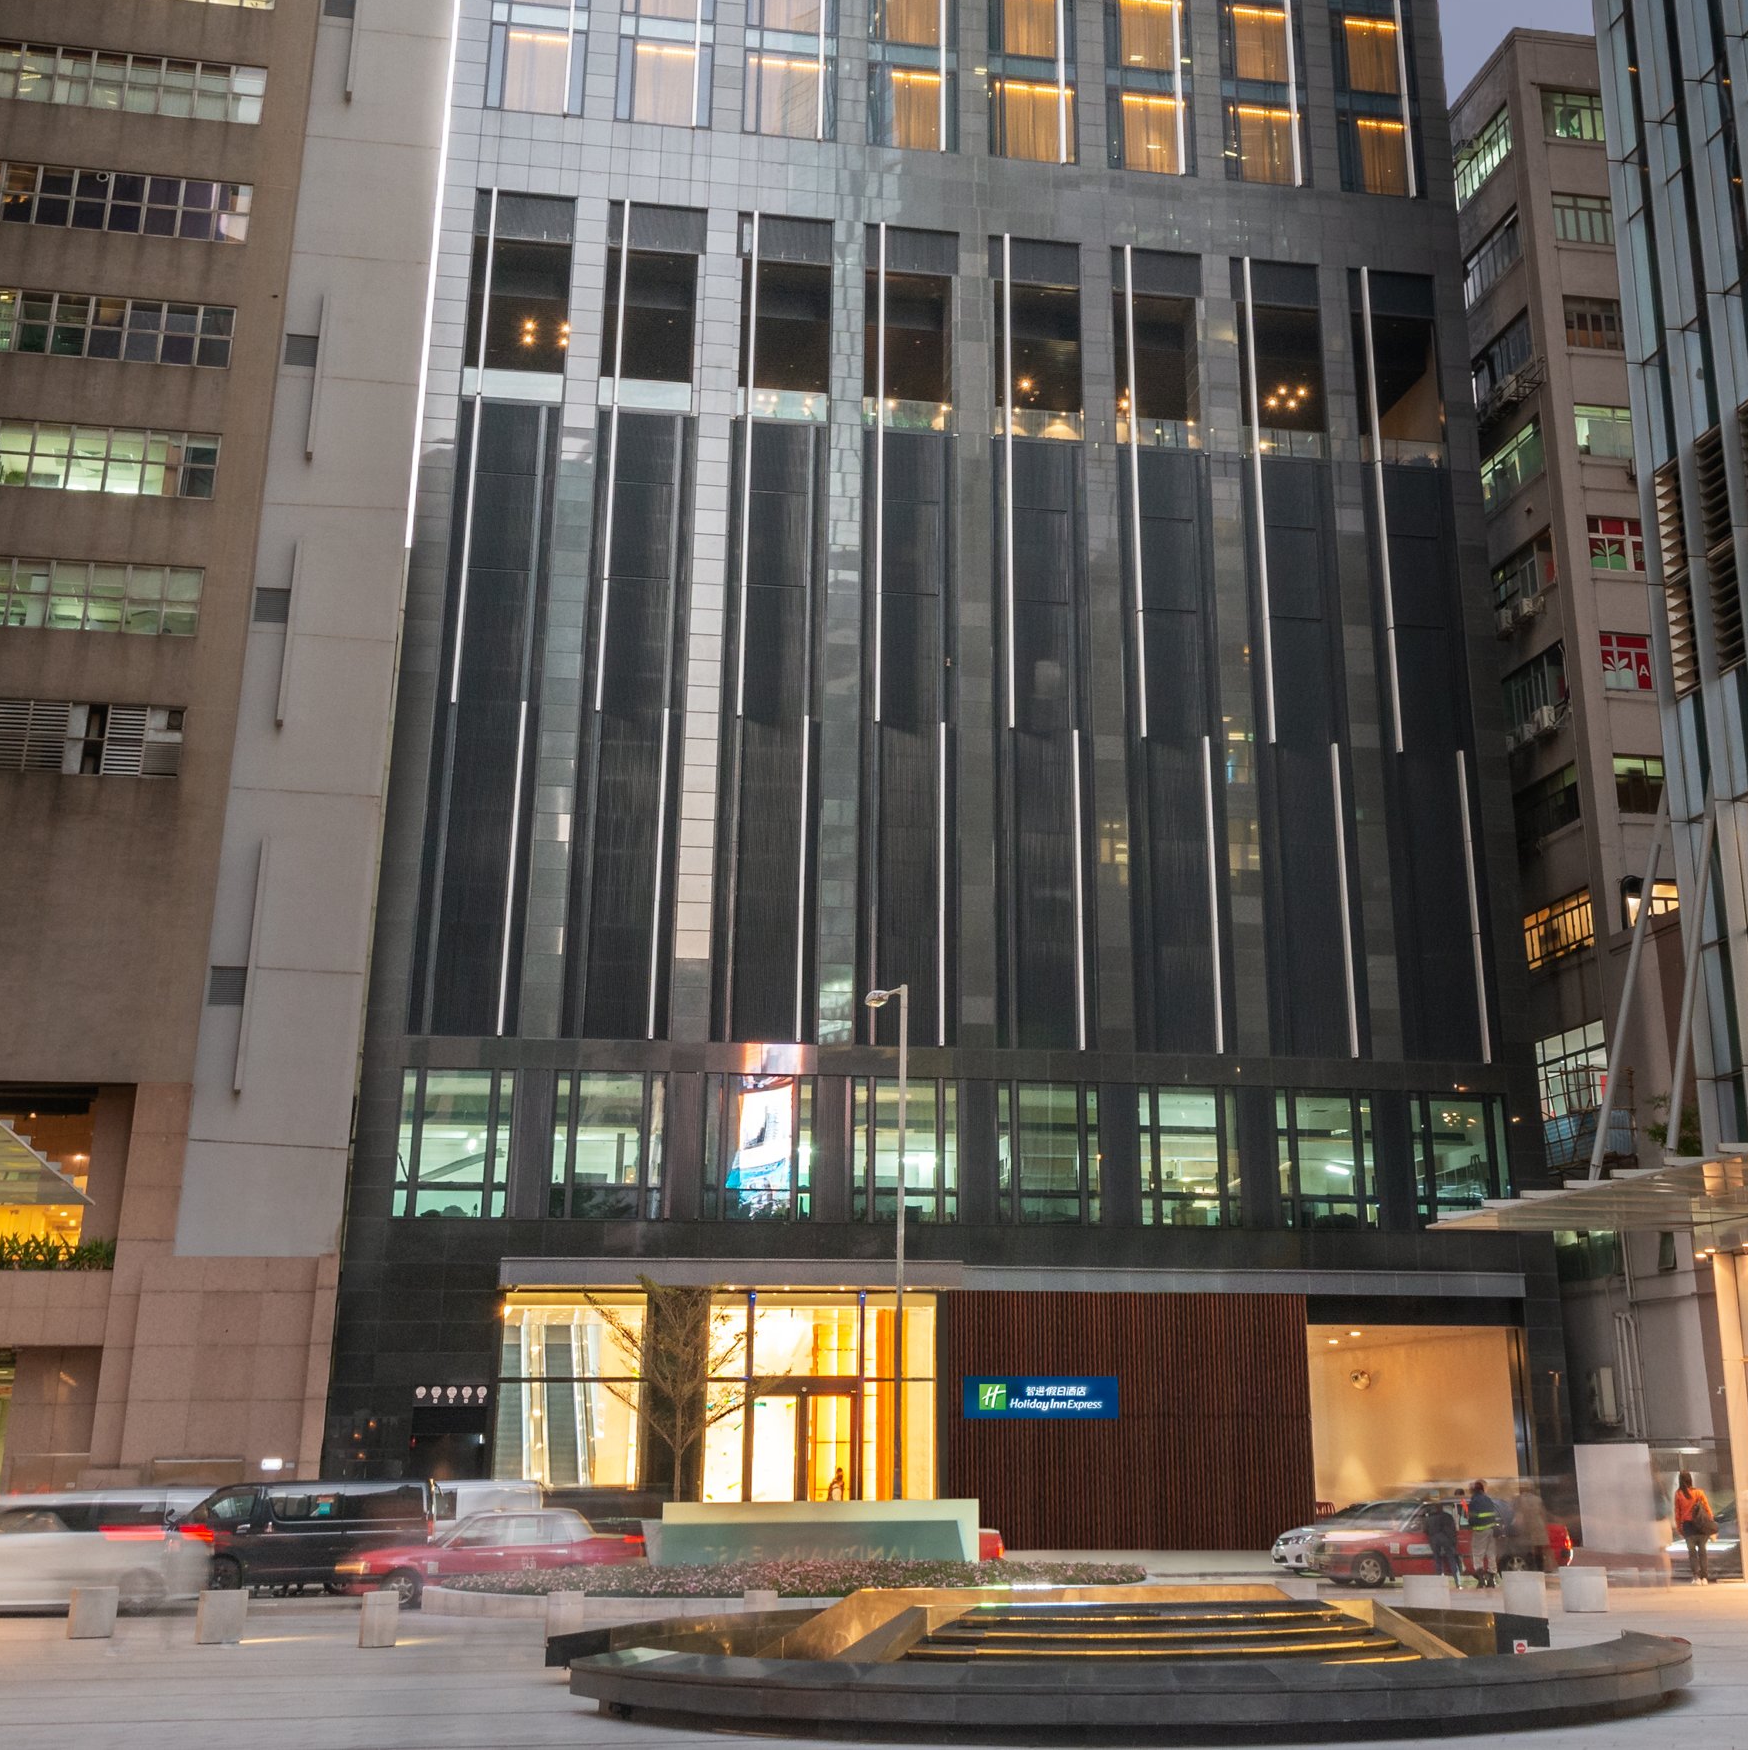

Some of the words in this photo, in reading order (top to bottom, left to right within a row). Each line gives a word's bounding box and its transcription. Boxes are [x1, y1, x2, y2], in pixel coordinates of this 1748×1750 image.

[1638, 664, 1650, 677] A
[1009, 1398, 1050, 1410] Holiday
[1050, 1398, 1067, 1408] Inn
[1068, 1399, 1102, 1410] Express
